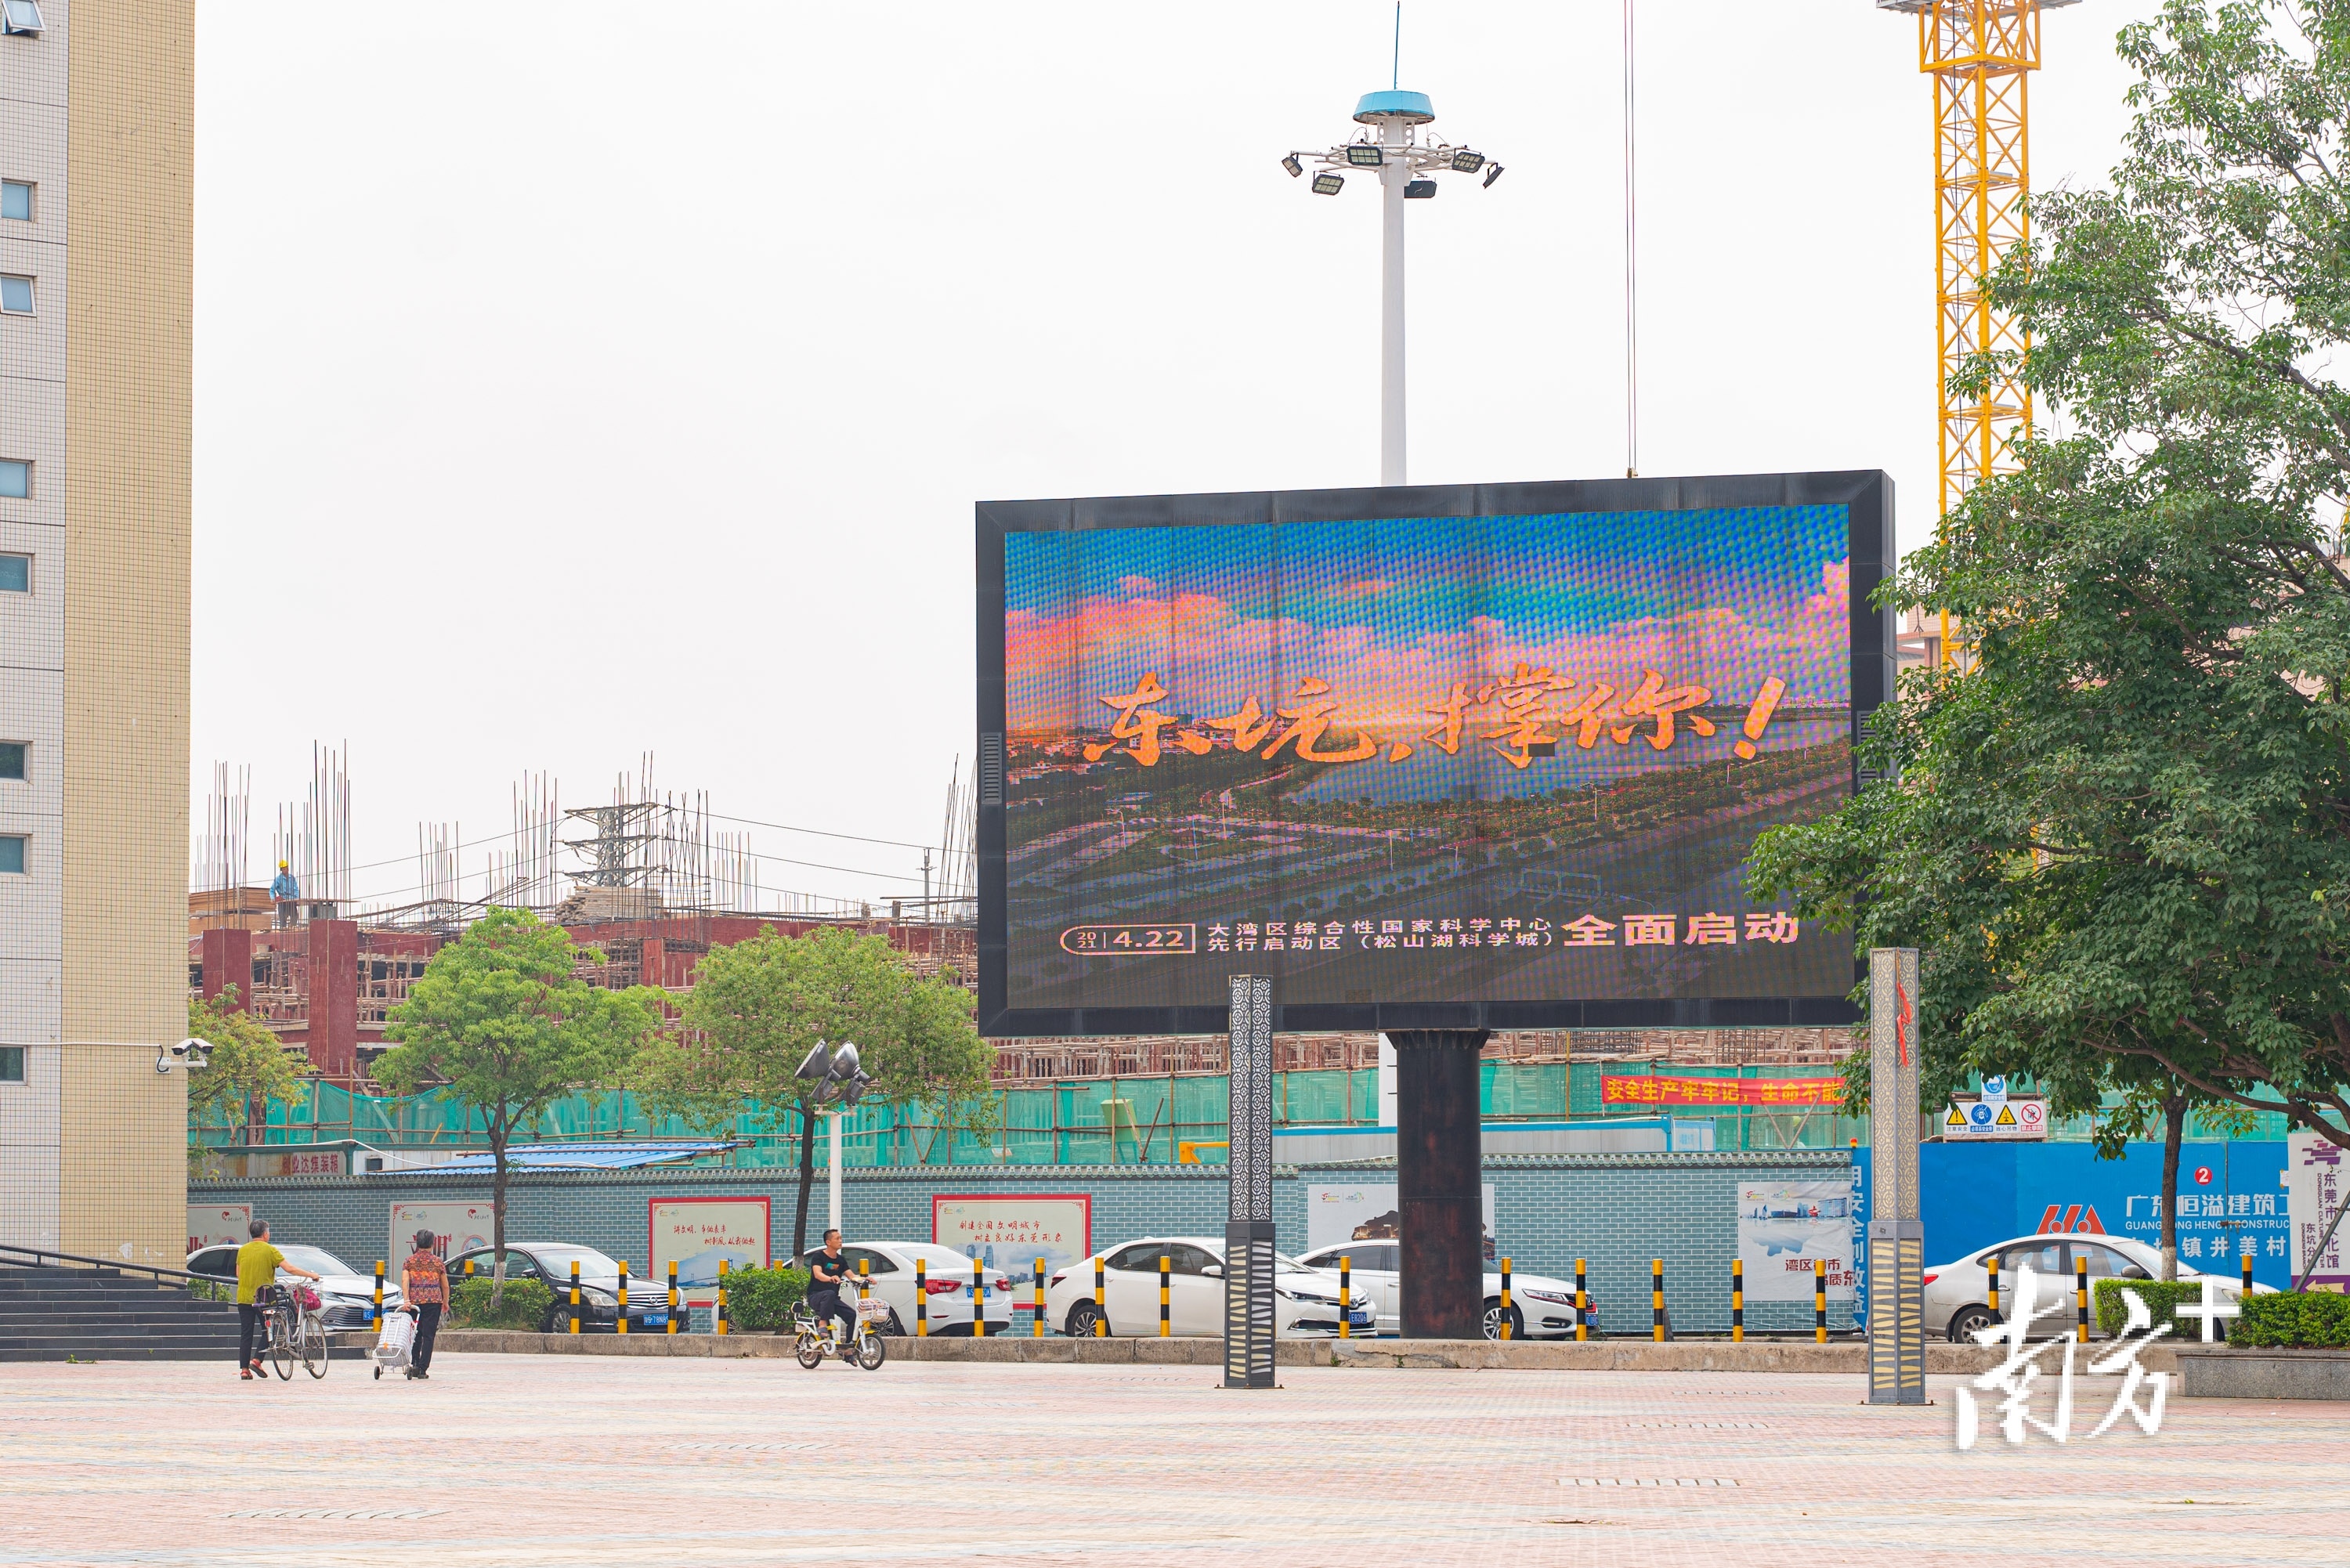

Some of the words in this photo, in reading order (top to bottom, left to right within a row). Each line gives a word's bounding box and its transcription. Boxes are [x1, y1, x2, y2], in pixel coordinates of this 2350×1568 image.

[1207, 917, 1552, 936] 大湾区综合性国家科学中心
[1561, 912, 1799, 947] 全面启动
[1112, 930, 1184, 948] 4.22
[1207, 932, 1553, 952] 先行启动区（松山湖科学城）
[1607, 1078, 1851, 1103] 安全生产牢牢记，生命不能
[2199, 1168, 2209, 1183] 2
[2125, 1220, 2193, 1230] GUANGNG
[2132, 1236, 2286, 1258] 镇井美村
[1786, 1259, 1841, 1271] 湾区市
